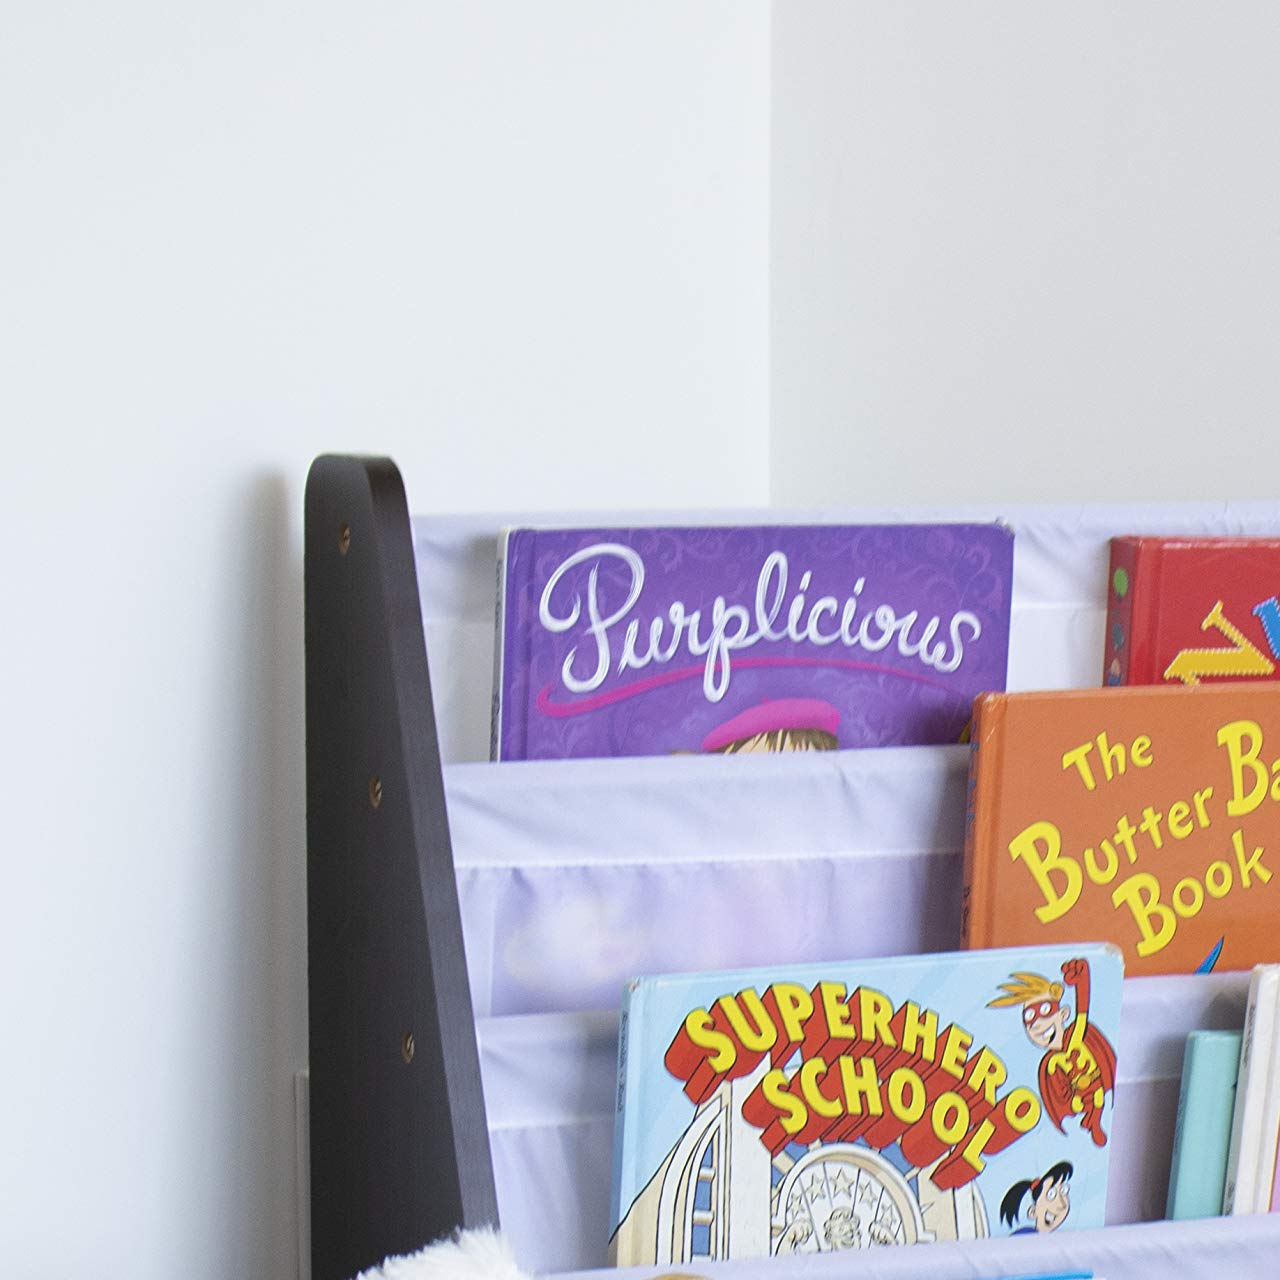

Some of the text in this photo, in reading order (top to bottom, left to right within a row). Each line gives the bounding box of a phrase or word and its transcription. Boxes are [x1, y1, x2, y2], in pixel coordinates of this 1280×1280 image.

[539, 543, 982, 703] Purplicious
[1061, 731, 1154, 791] The
[1008, 786, 1214, 925] Butter
[1112, 829, 1274, 958] Book
[680, 980, 1043, 1134] SUPERHERO
[760, 1054, 998, 1172] SCHOOL
